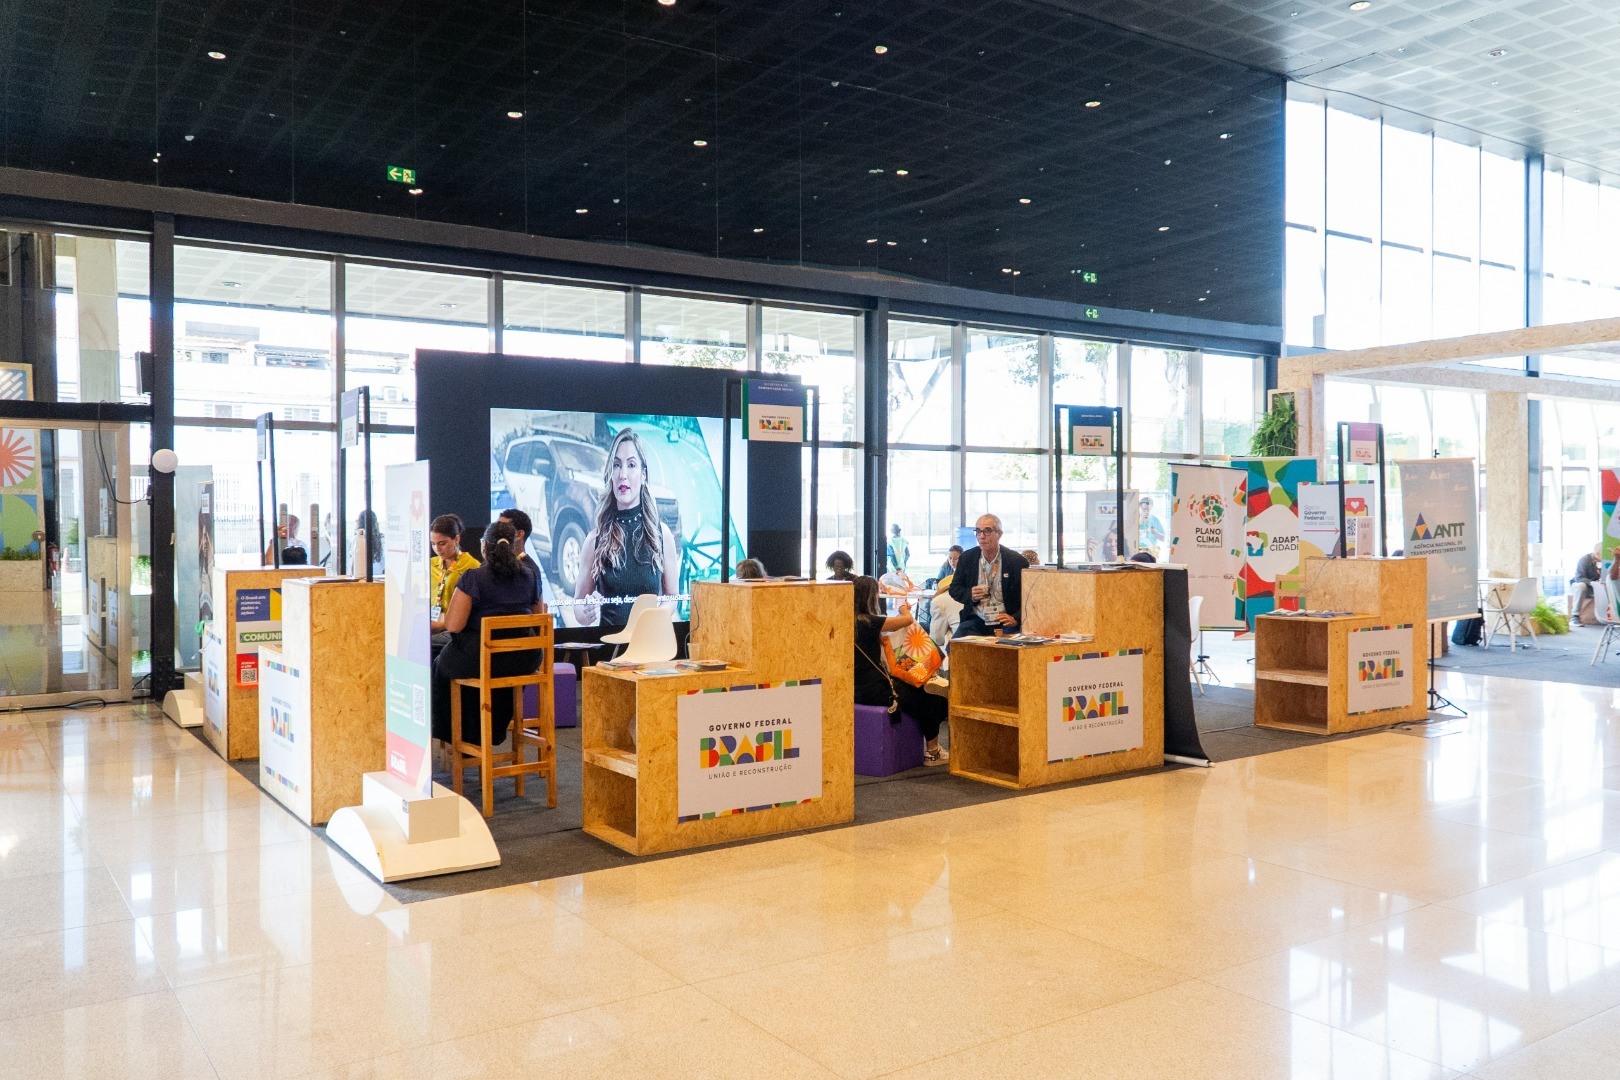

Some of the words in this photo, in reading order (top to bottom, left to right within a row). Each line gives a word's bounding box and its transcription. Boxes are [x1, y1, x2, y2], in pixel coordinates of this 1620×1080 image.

[759, 419, 793, 431] BRASIL
[1433, 522, 1465, 539] ANTT
[611, 596, 623, 605] seja,
[1359, 658, 1403, 682] BRASIL
[1068, 684, 1096, 692] GOVERNO
[1063, 691, 1128, 722] BRASIL
[709, 722, 751, 731] GOVERNO
[755, 718, 792, 727] FEDERAL
[1089, 719, 1124, 728] RECONSTRUÇÃO
[700, 729, 799, 768] BRASIL
[709, 771, 730, 779] UNIÃO
[740, 764, 792, 776] RECONSTRUÇÃO
